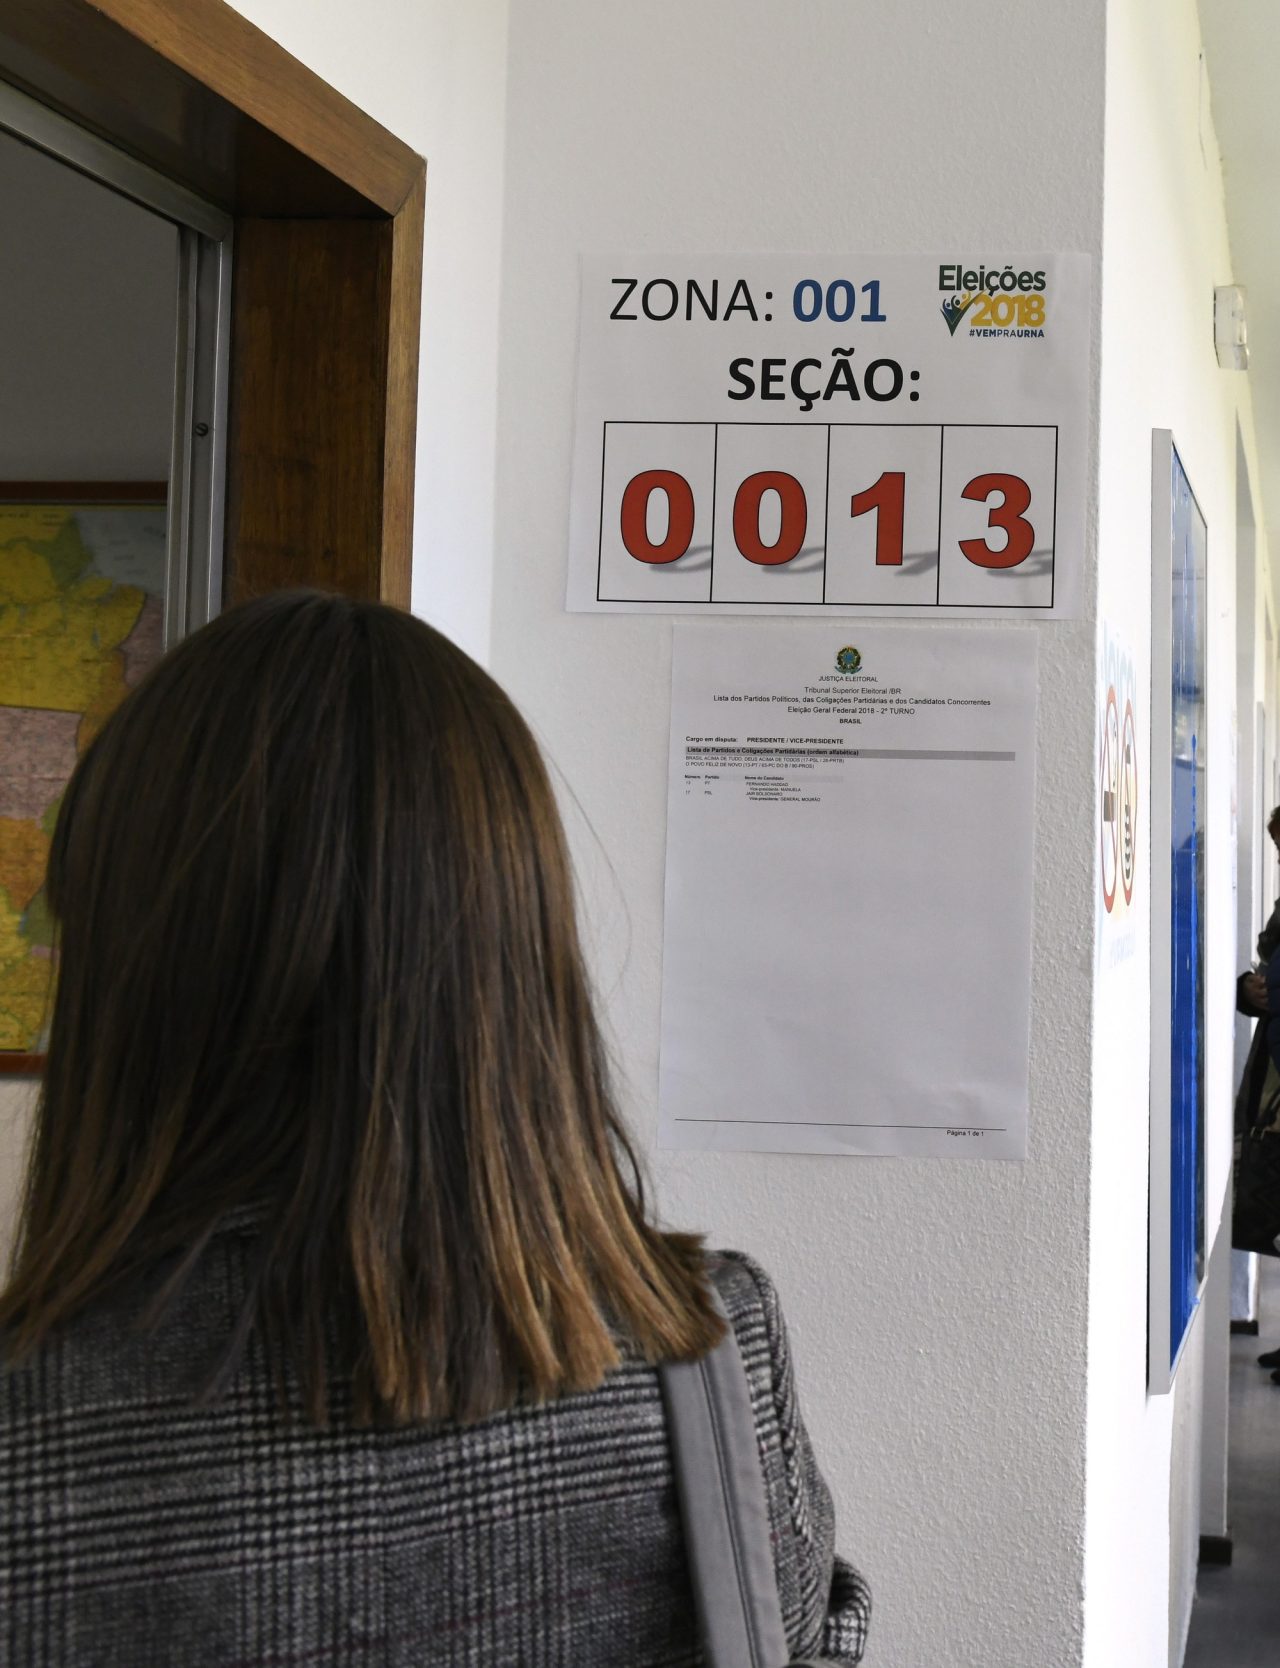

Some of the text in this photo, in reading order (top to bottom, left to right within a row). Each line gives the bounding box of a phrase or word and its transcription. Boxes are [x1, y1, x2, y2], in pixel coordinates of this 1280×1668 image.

[939, 264, 1046, 297] Eleições
[609, 279, 887, 323] ZONA: 001
[970, 293, 1046, 328] 2018
[969, 328, 1045, 338] #VEMPRAURNA
[727, 347, 920, 411] SEÇÃO:
[787, 706, 811, 714] Eleição
